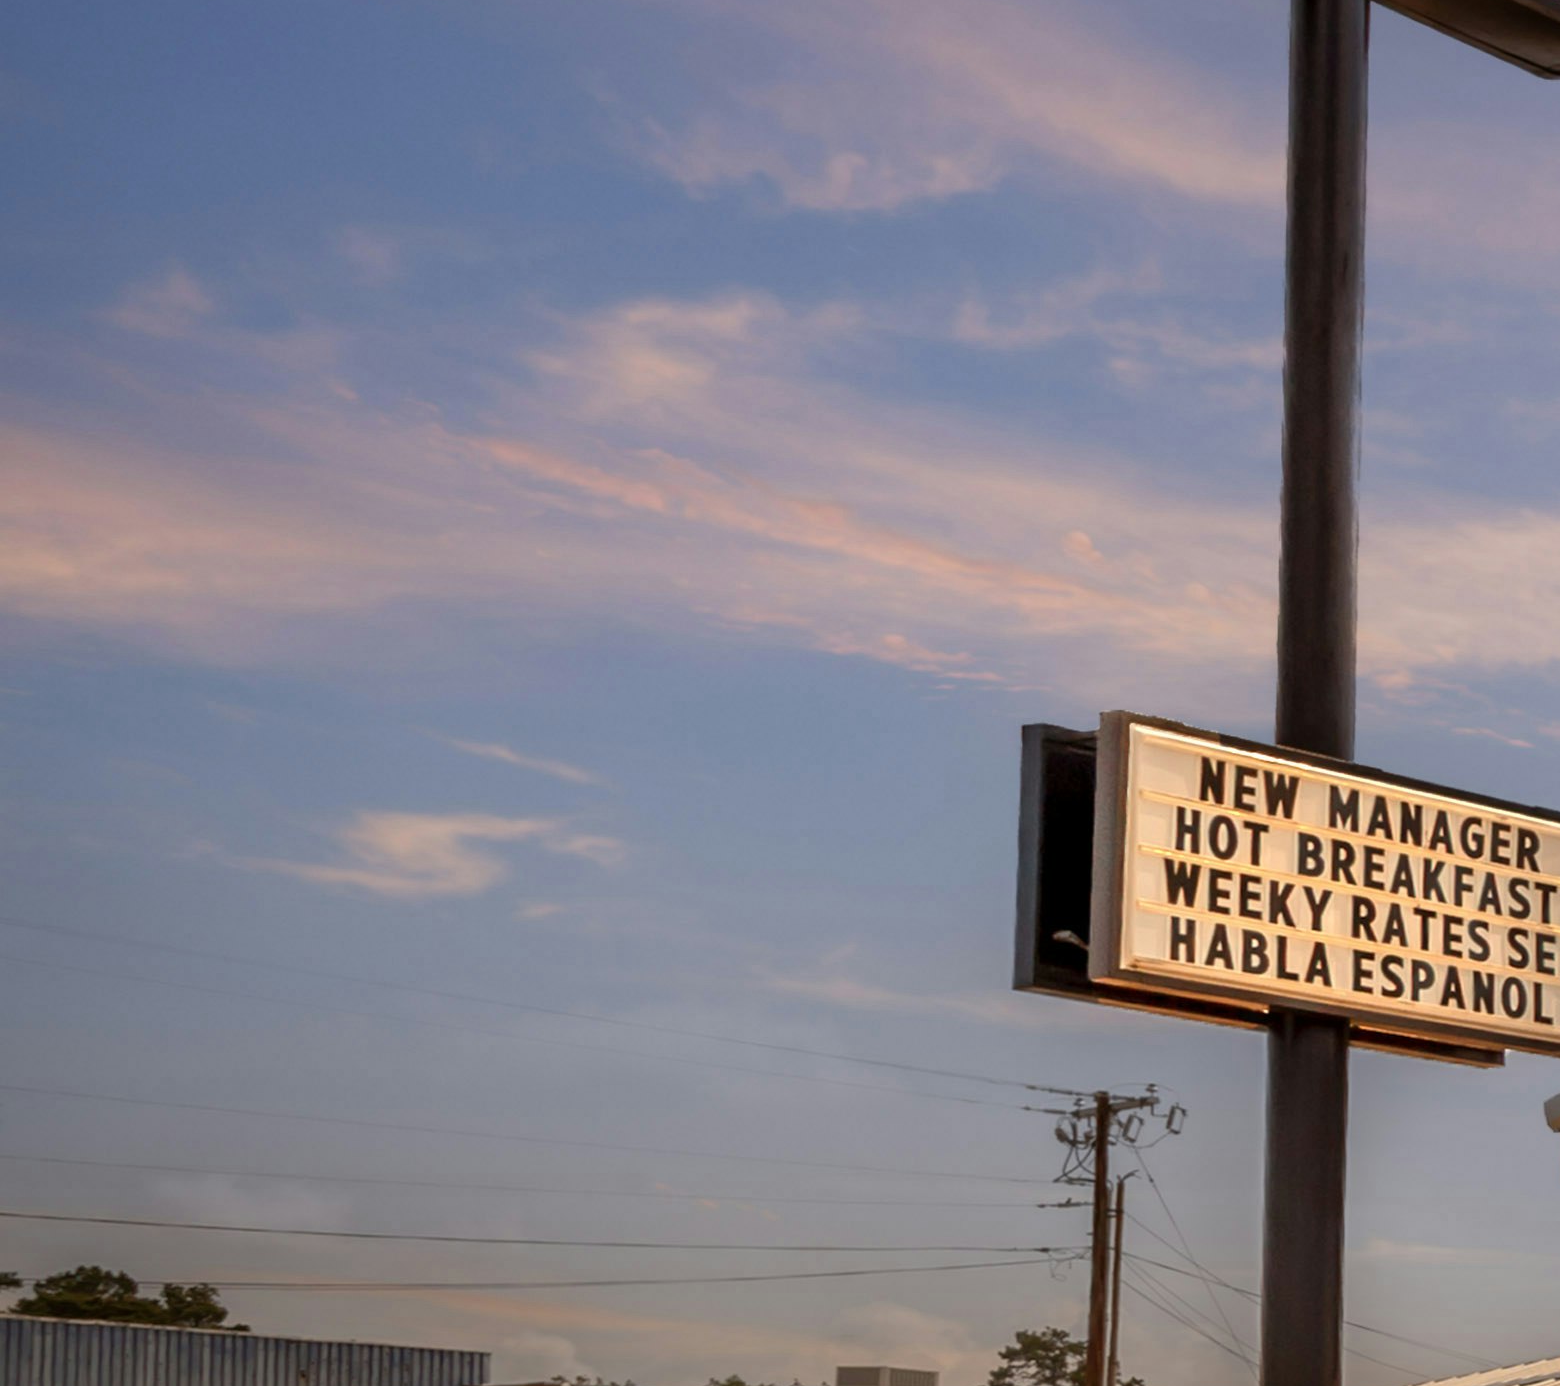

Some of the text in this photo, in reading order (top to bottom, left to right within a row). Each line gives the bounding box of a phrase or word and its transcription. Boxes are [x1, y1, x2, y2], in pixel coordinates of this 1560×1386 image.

[1175, 805, 1557, 924] HOT BREAKFAST
[1199, 755, 1541, 873] NEW MANAGER
[1164, 857, 1557, 977] WEEKY RATES SE
[1169, 915, 1554, 1026] HABLA ESPANOL
